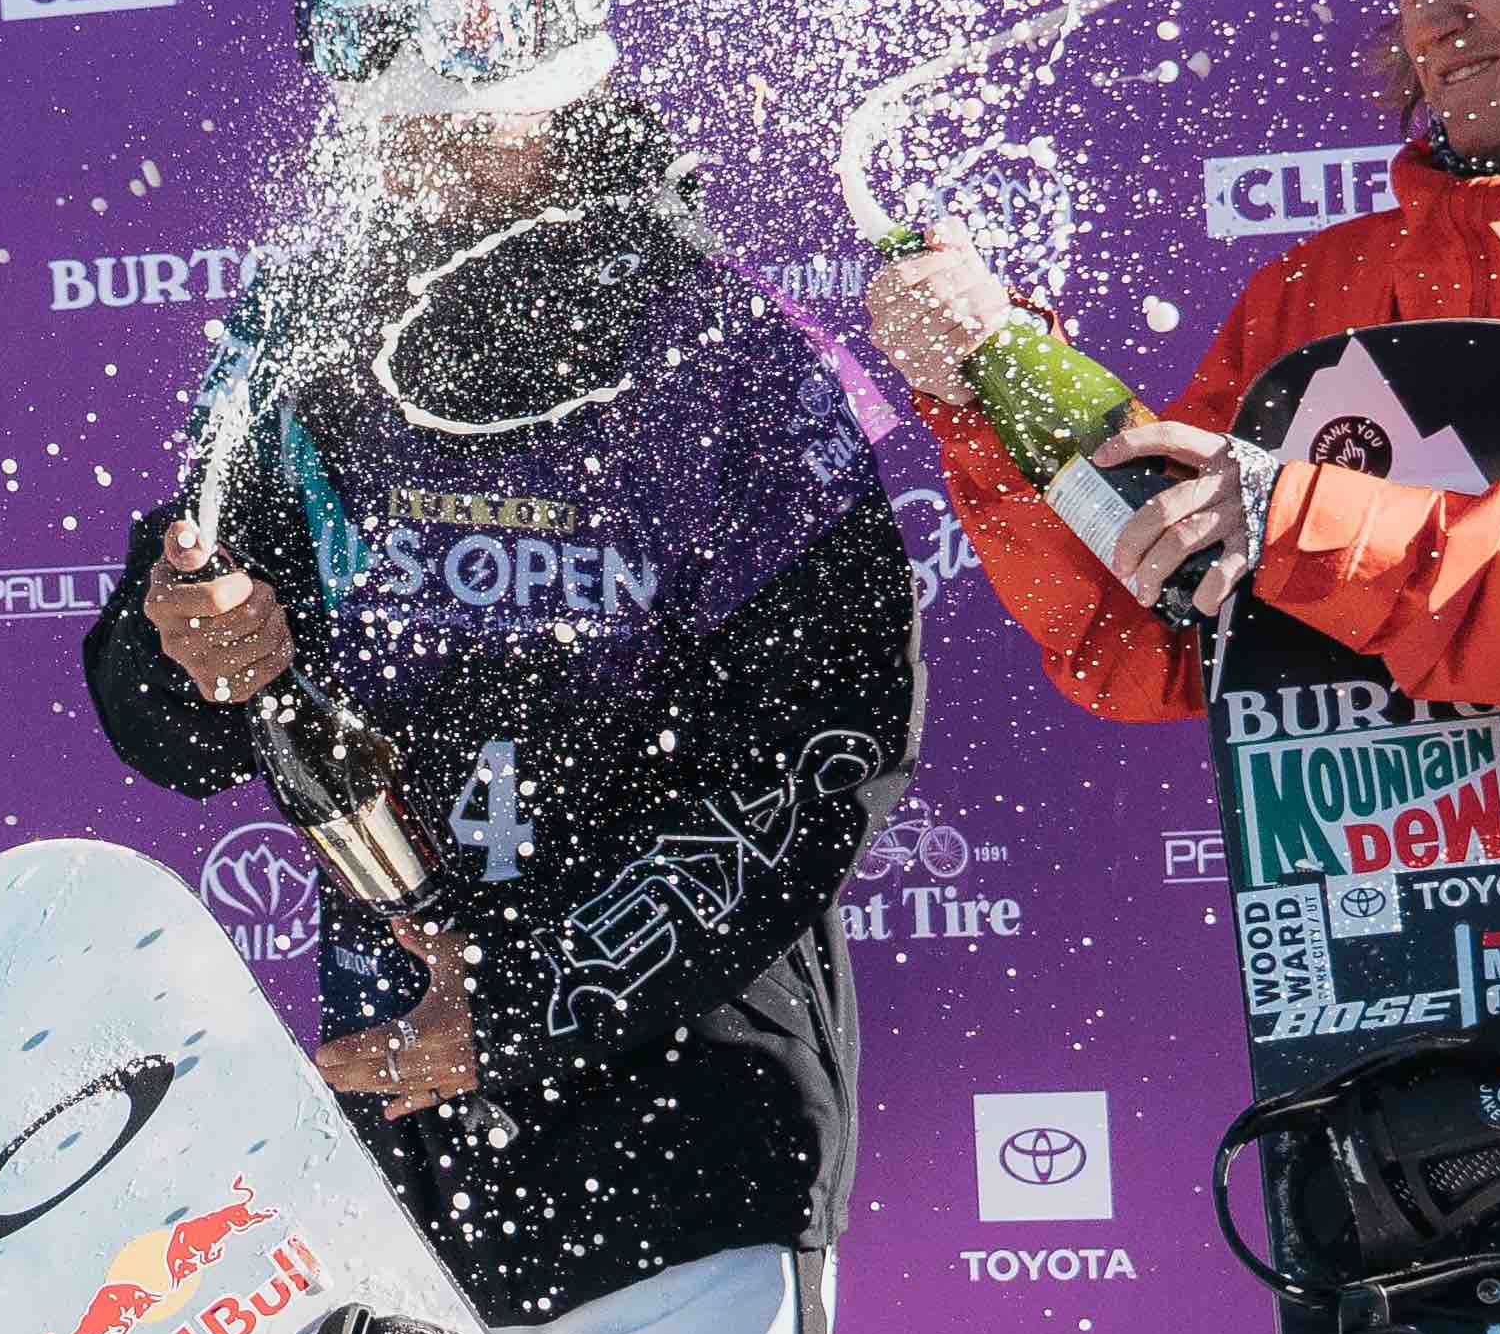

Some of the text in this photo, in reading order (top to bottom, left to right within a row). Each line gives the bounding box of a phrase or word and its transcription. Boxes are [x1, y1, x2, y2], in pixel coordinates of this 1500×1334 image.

[1230, 158, 1392, 224] CLIF
[1315, 421, 1384, 463] THANK YOU
[444, 533, 659, 616] OPEN
[449, 740, 534, 882] 4
[973, 844, 1009, 863] 1991
[233, 923, 283, 961] AIL
[841, 886, 1021, 942] at Tire
[1244, 901, 1280, 1008] WOOD
[1275, 897, 1313, 1004] WARD
[1256, 990, 1456, 1044] BOSE
[959, 1248, 1137, 1282] TOYOTA
